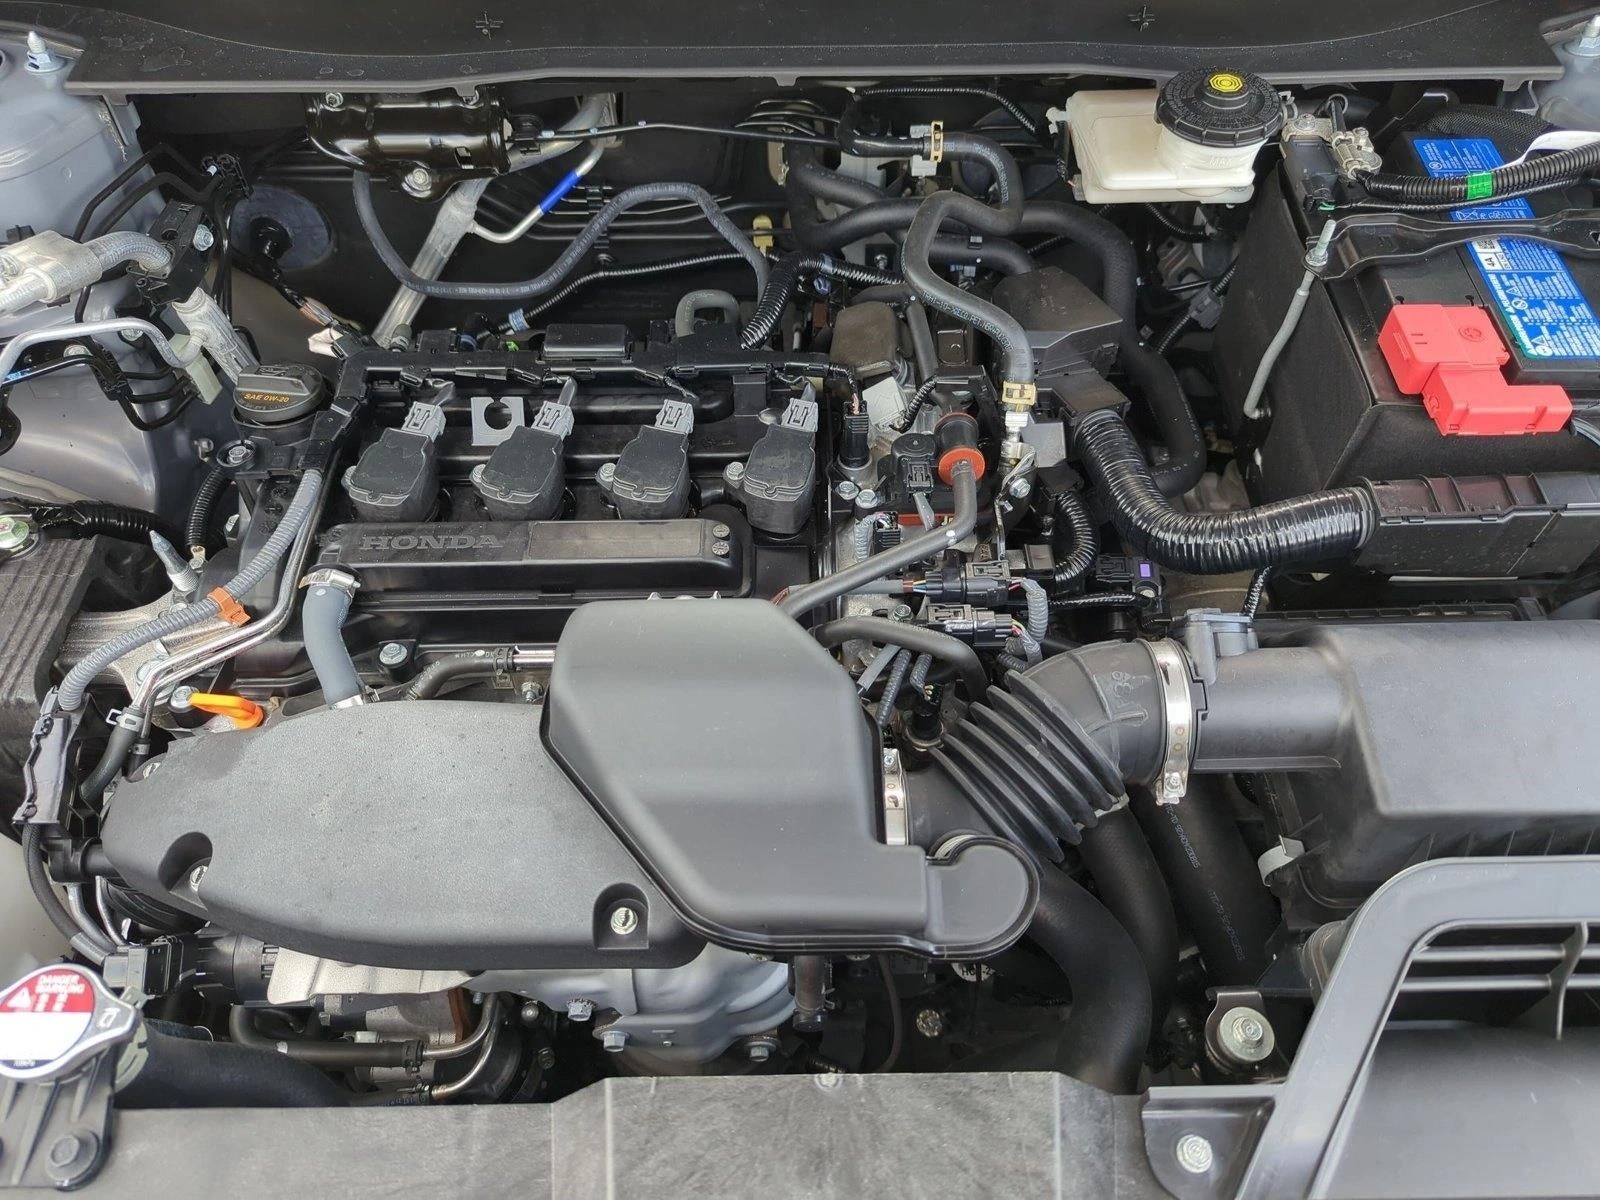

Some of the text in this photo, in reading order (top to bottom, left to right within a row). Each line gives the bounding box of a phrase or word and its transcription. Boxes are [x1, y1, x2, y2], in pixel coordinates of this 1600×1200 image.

[244, 393, 290, 403] SAE 0W-20
[360, 535, 504, 550] HONDA
[961, 967, 990, 977] HC-2
